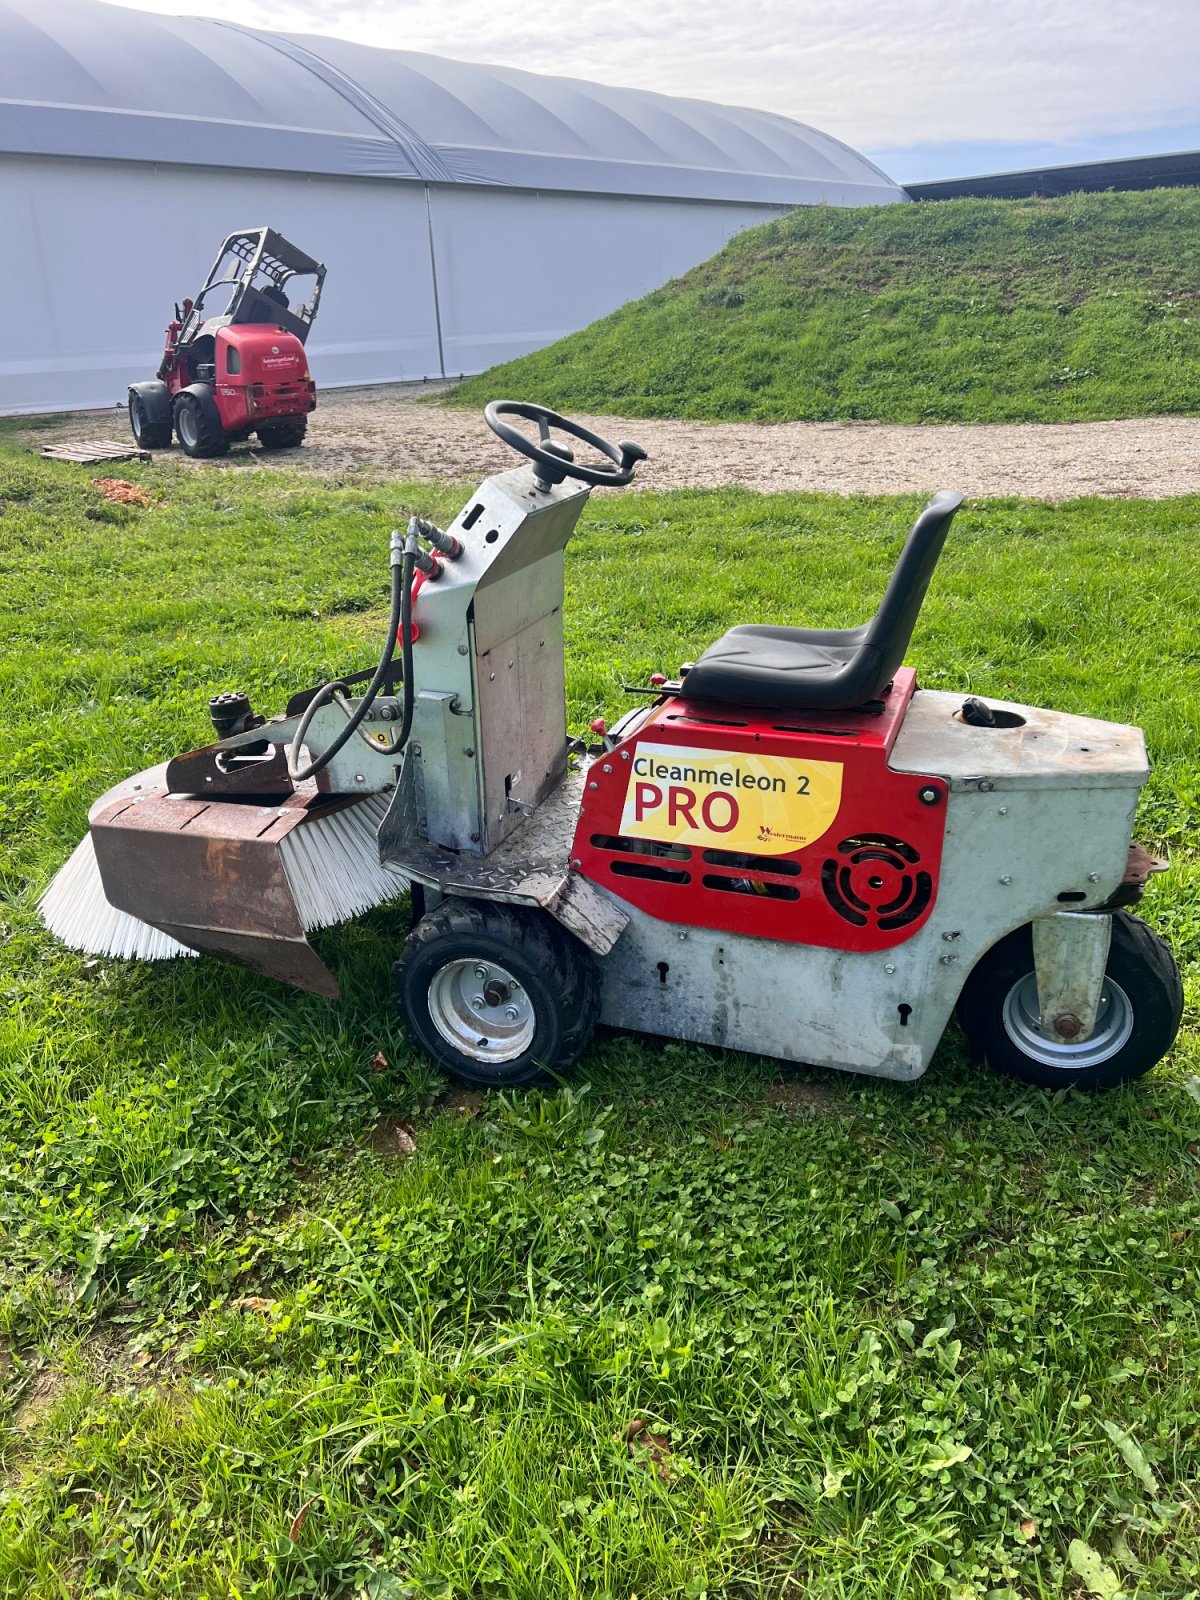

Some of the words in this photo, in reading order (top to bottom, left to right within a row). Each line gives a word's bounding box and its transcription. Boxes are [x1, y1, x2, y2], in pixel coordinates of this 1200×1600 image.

[633, 757, 786, 793] Cleanmeleon
[796, 776, 811, 796] 2
[635, 782, 740, 833] PRO
[759, 825, 807, 841] Westermann
